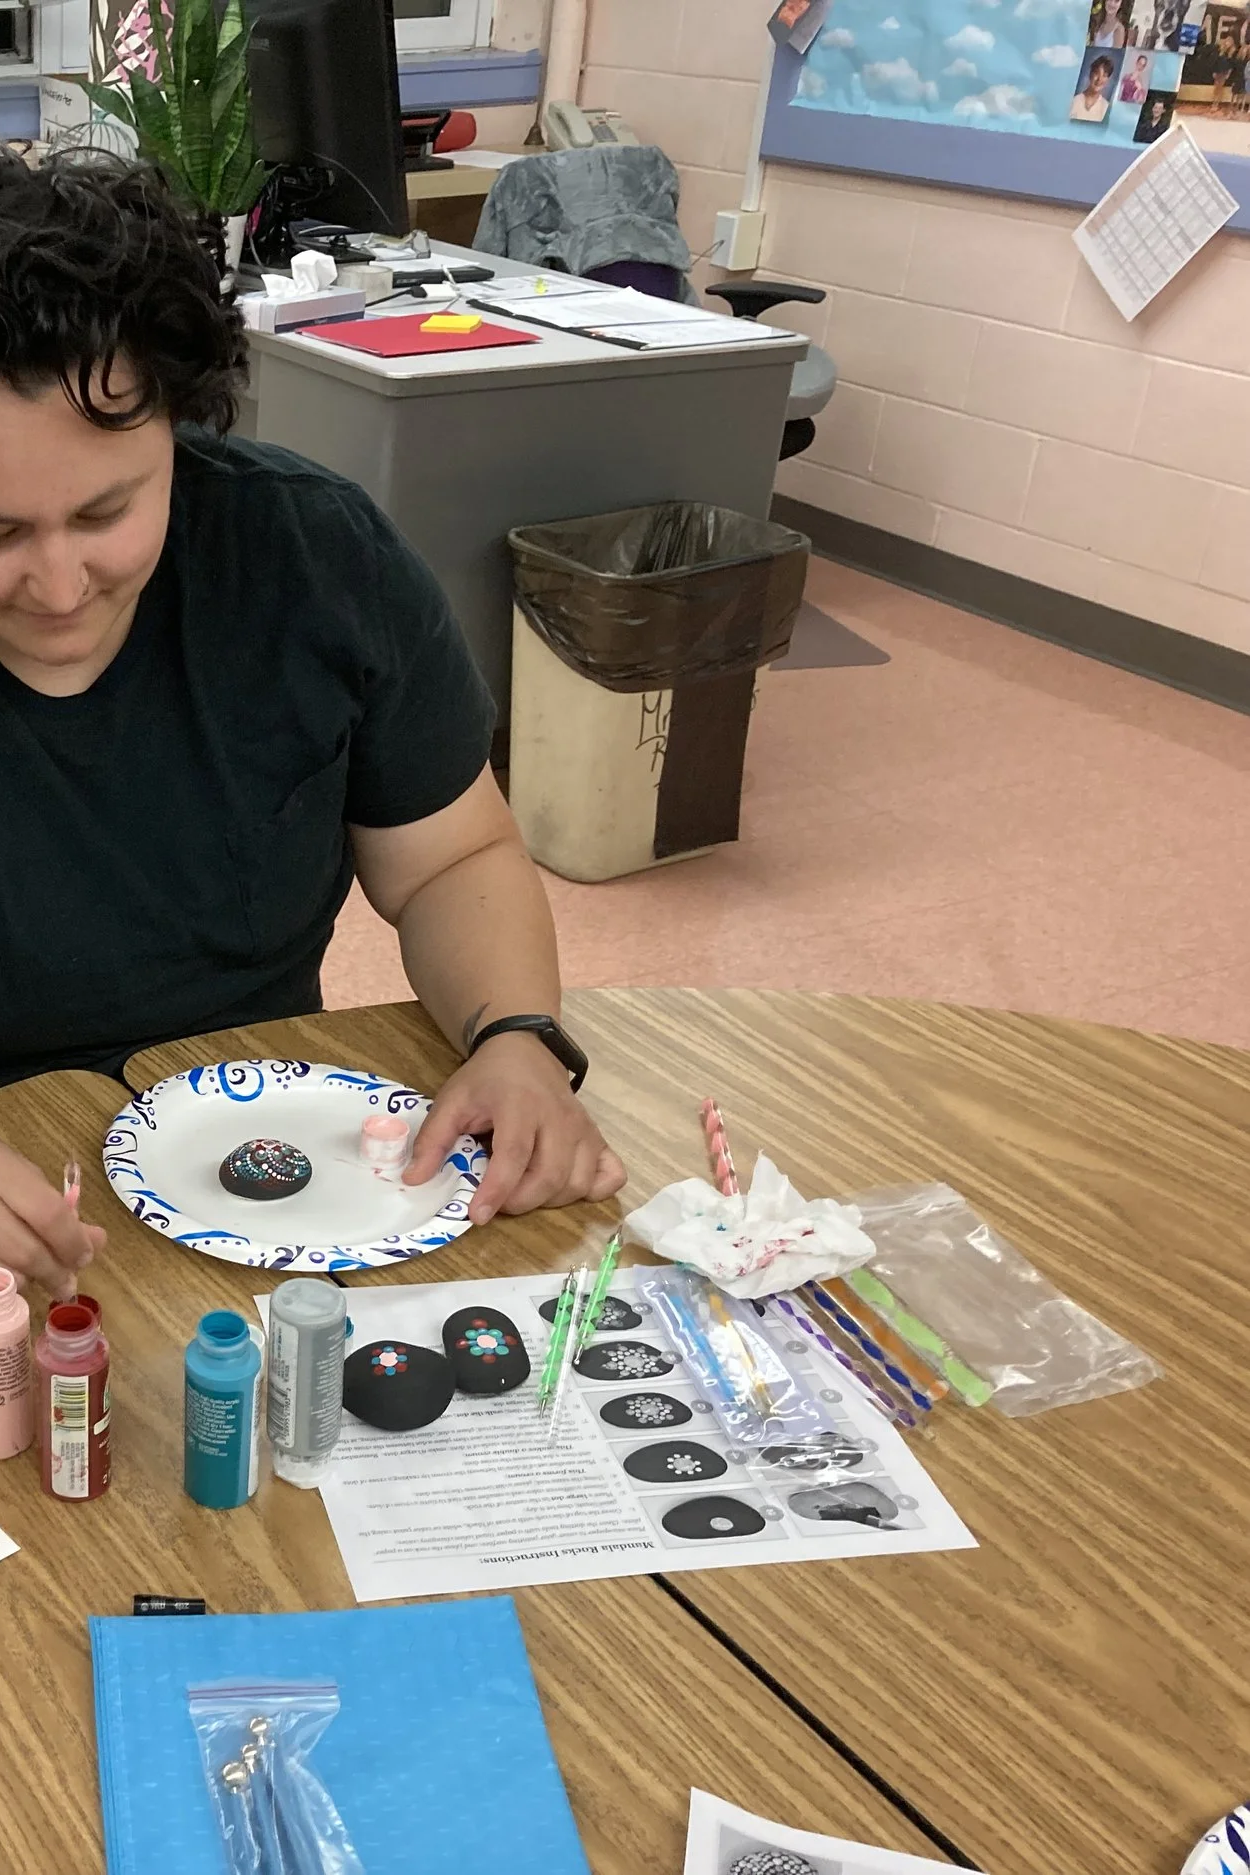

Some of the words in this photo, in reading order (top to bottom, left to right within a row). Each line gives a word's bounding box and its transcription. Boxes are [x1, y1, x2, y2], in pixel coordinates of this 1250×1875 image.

[559, 1545, 599, 1556] Rocks
[599, 1540, 655, 1553] Mandala
[477, 1549, 560, 1565] Instructions:
